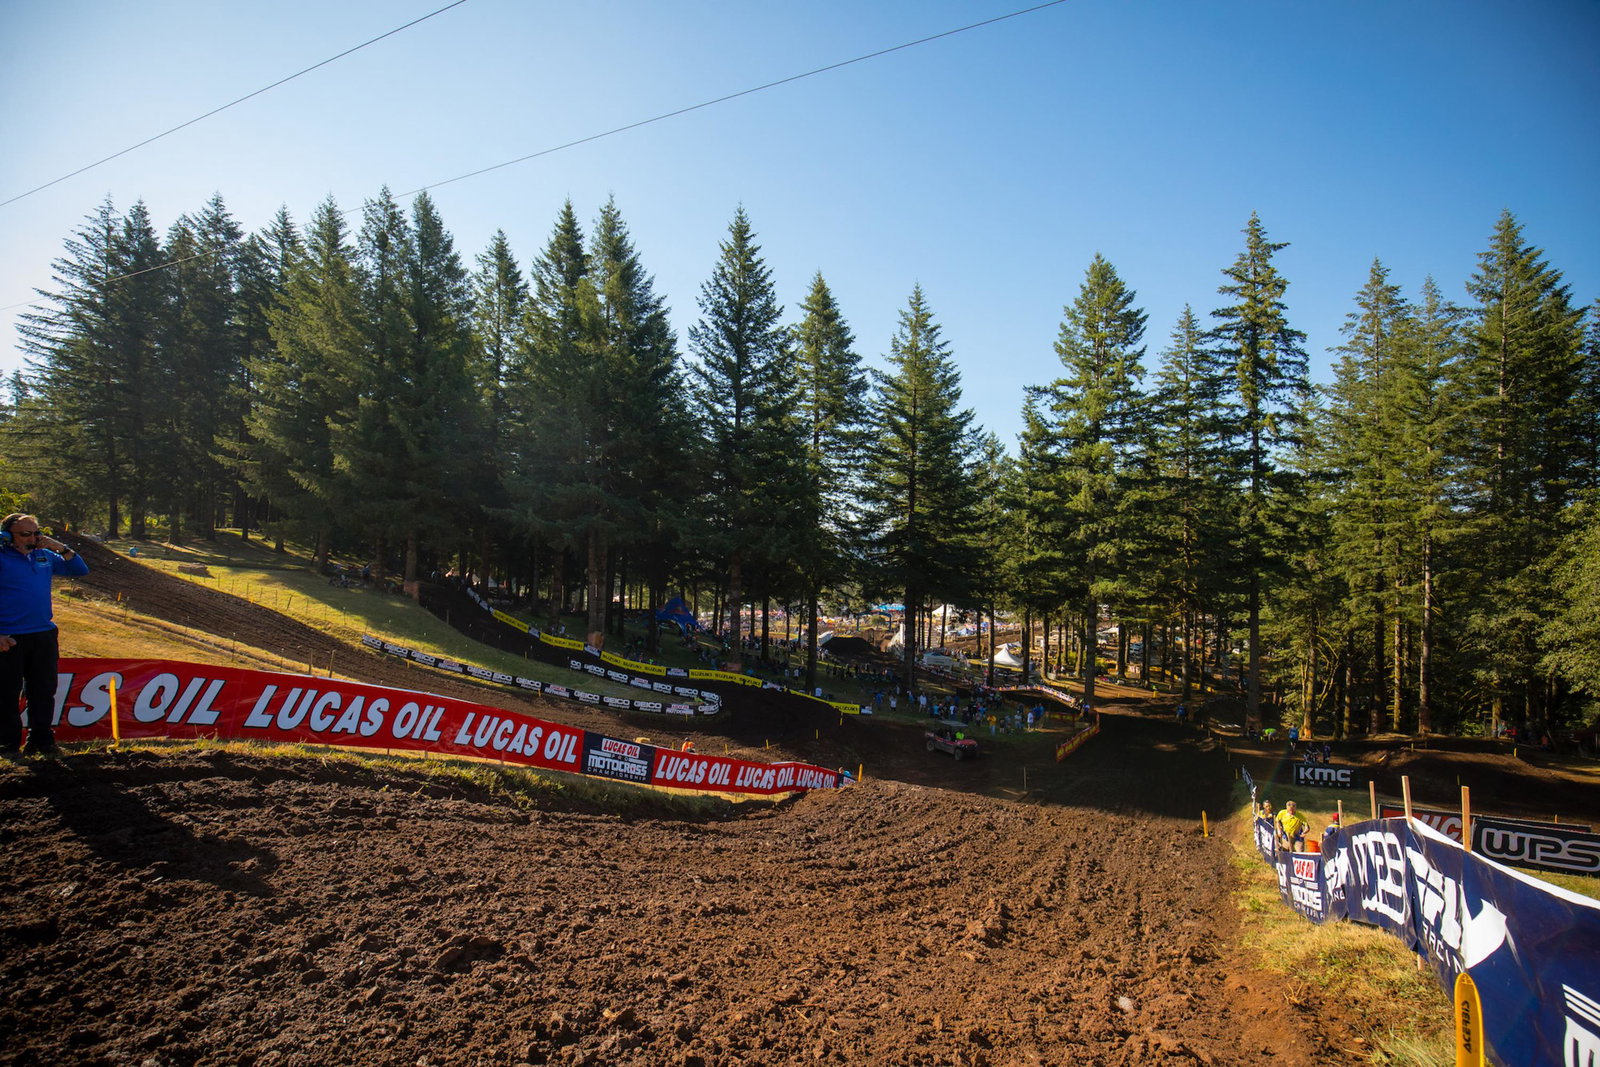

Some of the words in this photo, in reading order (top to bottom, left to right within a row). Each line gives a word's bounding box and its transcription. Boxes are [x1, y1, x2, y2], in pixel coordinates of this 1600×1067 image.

[411, 650, 436, 662] GEICO
[467, 665, 492, 677] GEICO
[607, 669, 629, 680] GEICO
[515, 676, 542, 688] GEICO
[674, 686, 699, 695] GEICO
[133, 672, 225, 725] OIL
[573, 690, 600, 701] GEICO
[603, 695, 630, 706] GEICO
[633, 700, 662, 709] GEICO
[243, 684, 390, 737] LUCAS
[392, 701, 446, 741] OIL
[454, 711, 543, 757] LUCAS
[544, 730, 578, 763] OIL
[603, 739, 627, 754] LUCAS
[627, 745, 639, 757] OIL
[587, 766, 647, 781] CHAMPIONSHIP
[588, 754, 647, 777] MOTOCROSS
[655, 755, 708, 784] LUCAS
[708, 762, 732, 786] OIL
[734, 765, 776, 790] LUCAS
[776, 767, 795, 788] OIL
[795, 768, 824, 788] LUCAS
[823, 773, 835, 788] OIL
[1481, 827, 1600, 872] WPS
[1461, 999, 1472, 1054] ACERBIS
